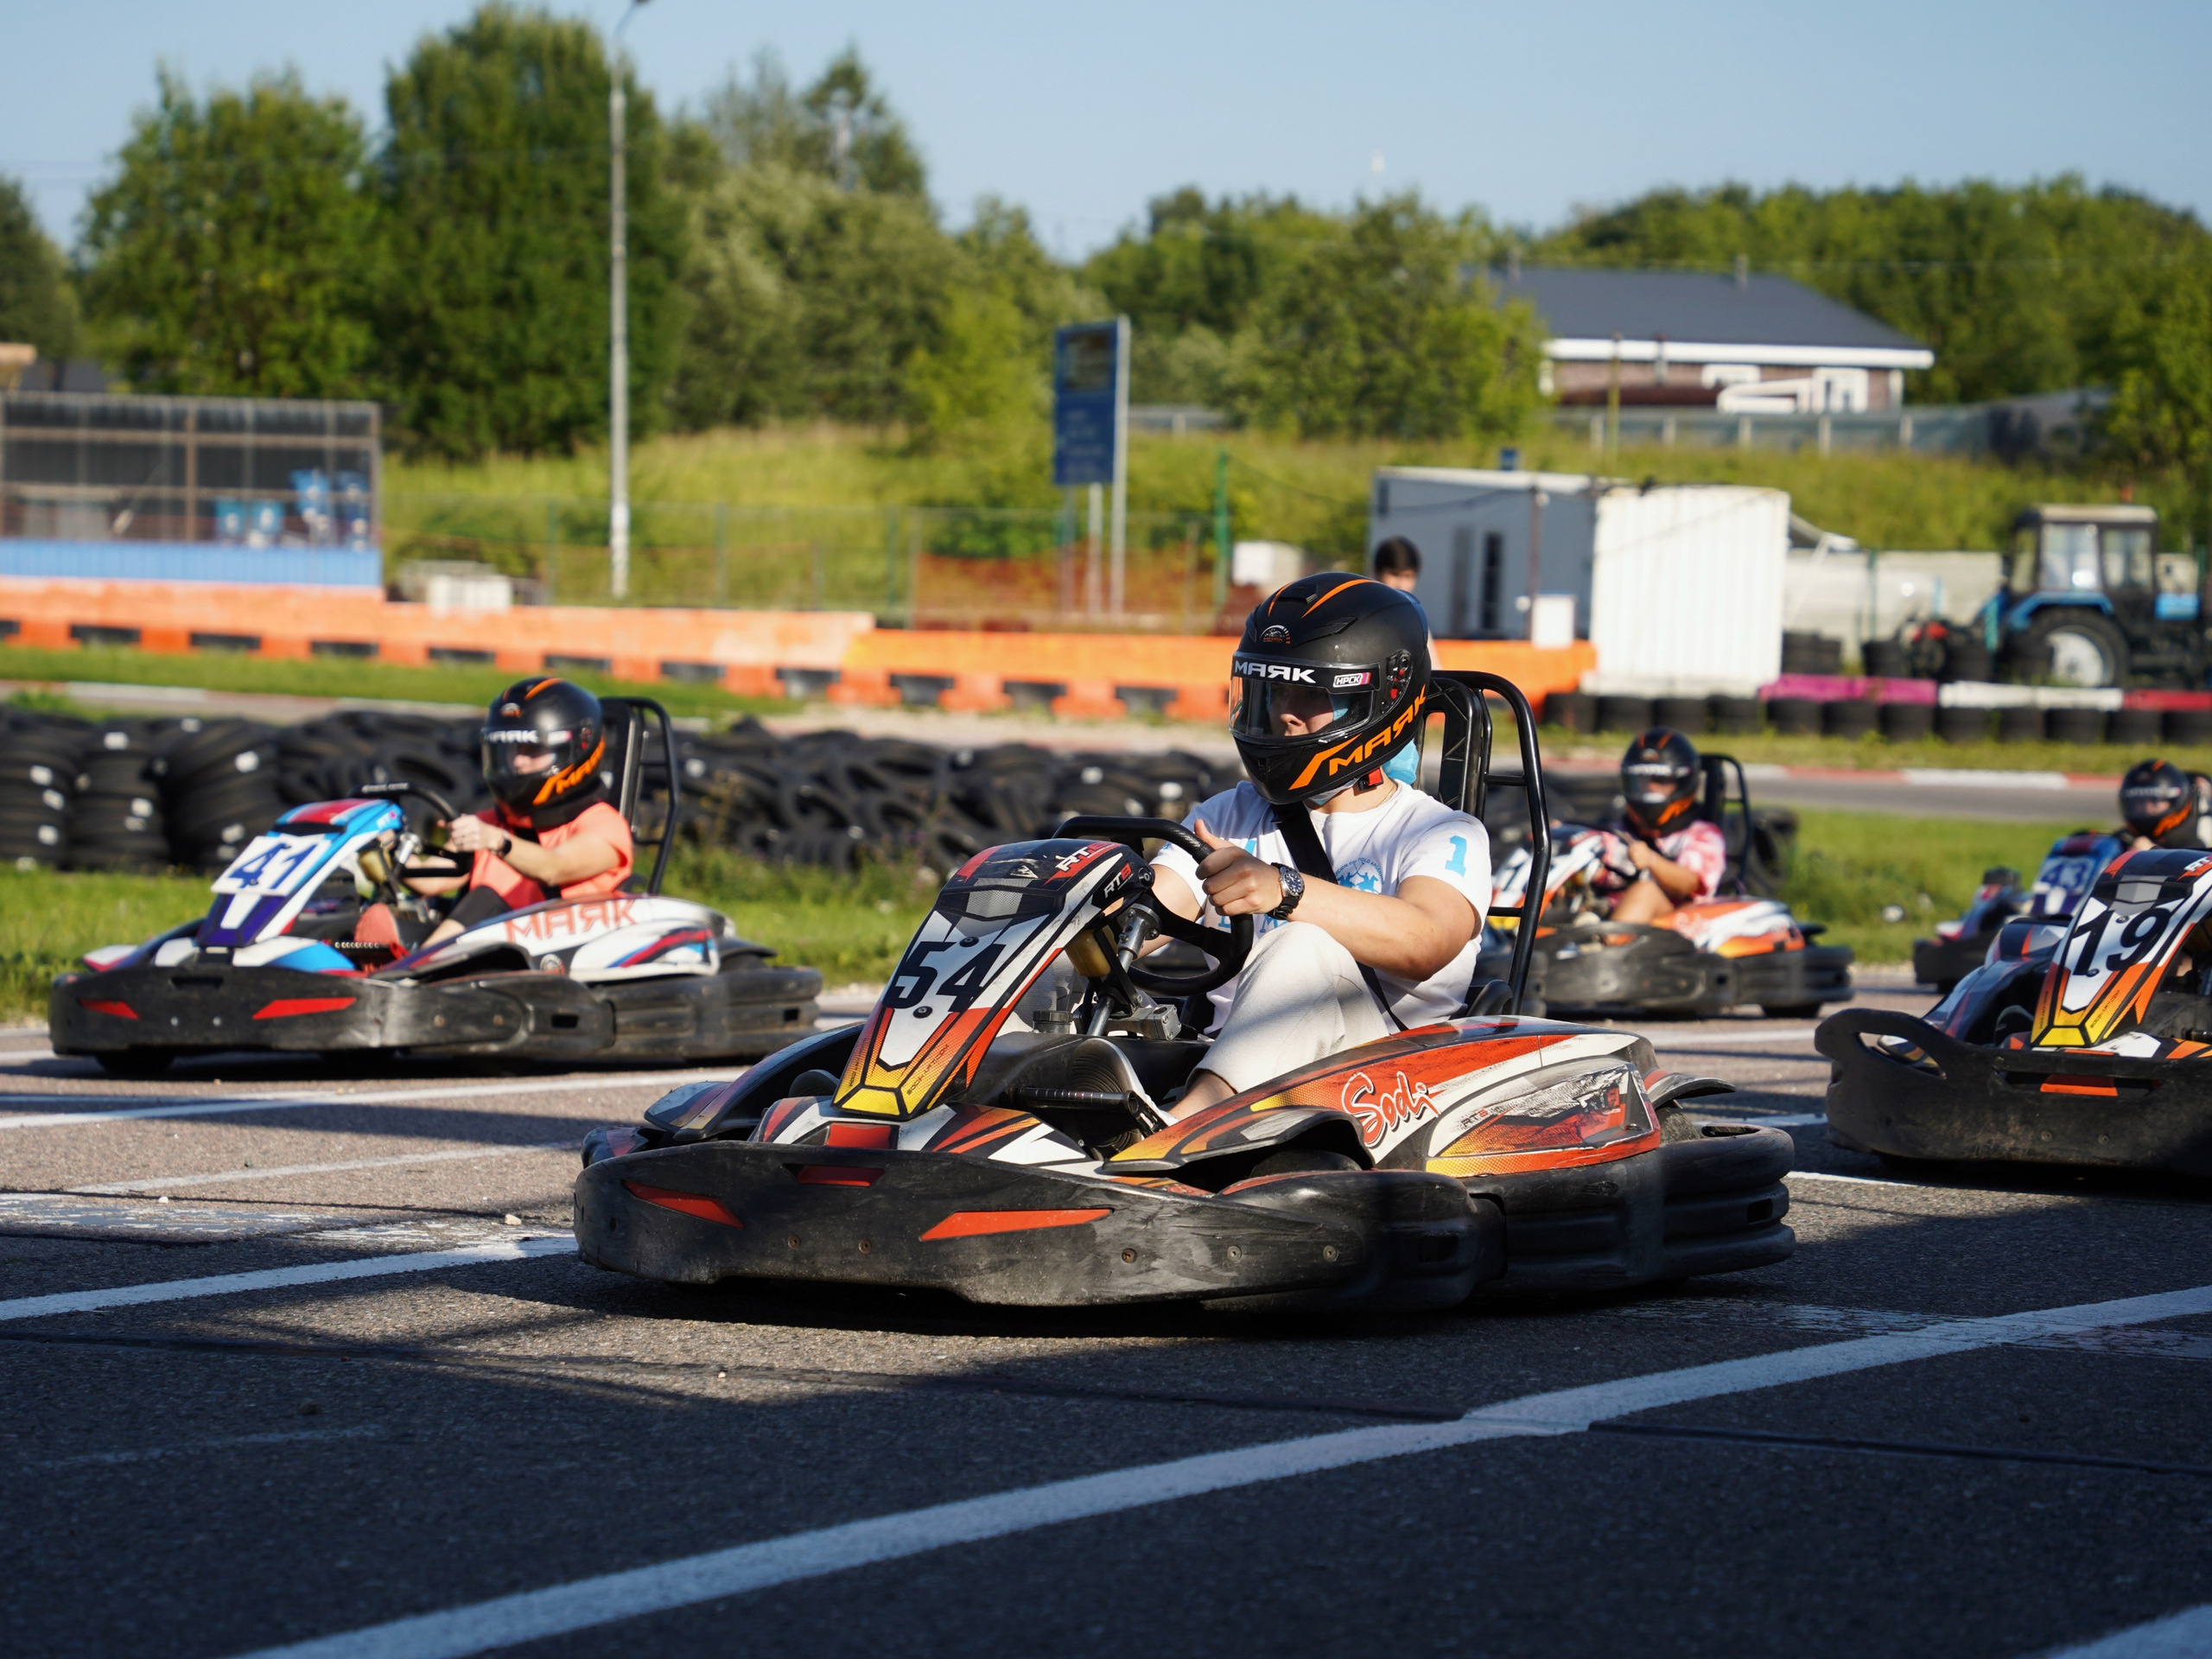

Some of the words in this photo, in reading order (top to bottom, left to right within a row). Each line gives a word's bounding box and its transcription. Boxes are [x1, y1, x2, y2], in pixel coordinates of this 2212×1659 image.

[1235, 660, 1316, 683] МАЯК
[1329, 683, 1427, 776] МАЯК
[227, 842, 318, 890] 41
[1444, 835, 1467, 877] 1
[2183, 855, 2212, 873] RT
[1103, 862, 1133, 899] RT8
[504, 898, 638, 944] МАЯК
[2071, 907, 2172, 976] 19
[881, 940, 1007, 1013] 54
[1342, 1071, 1441, 1147] Sodi
[1460, 1109, 1489, 1129] RT8
